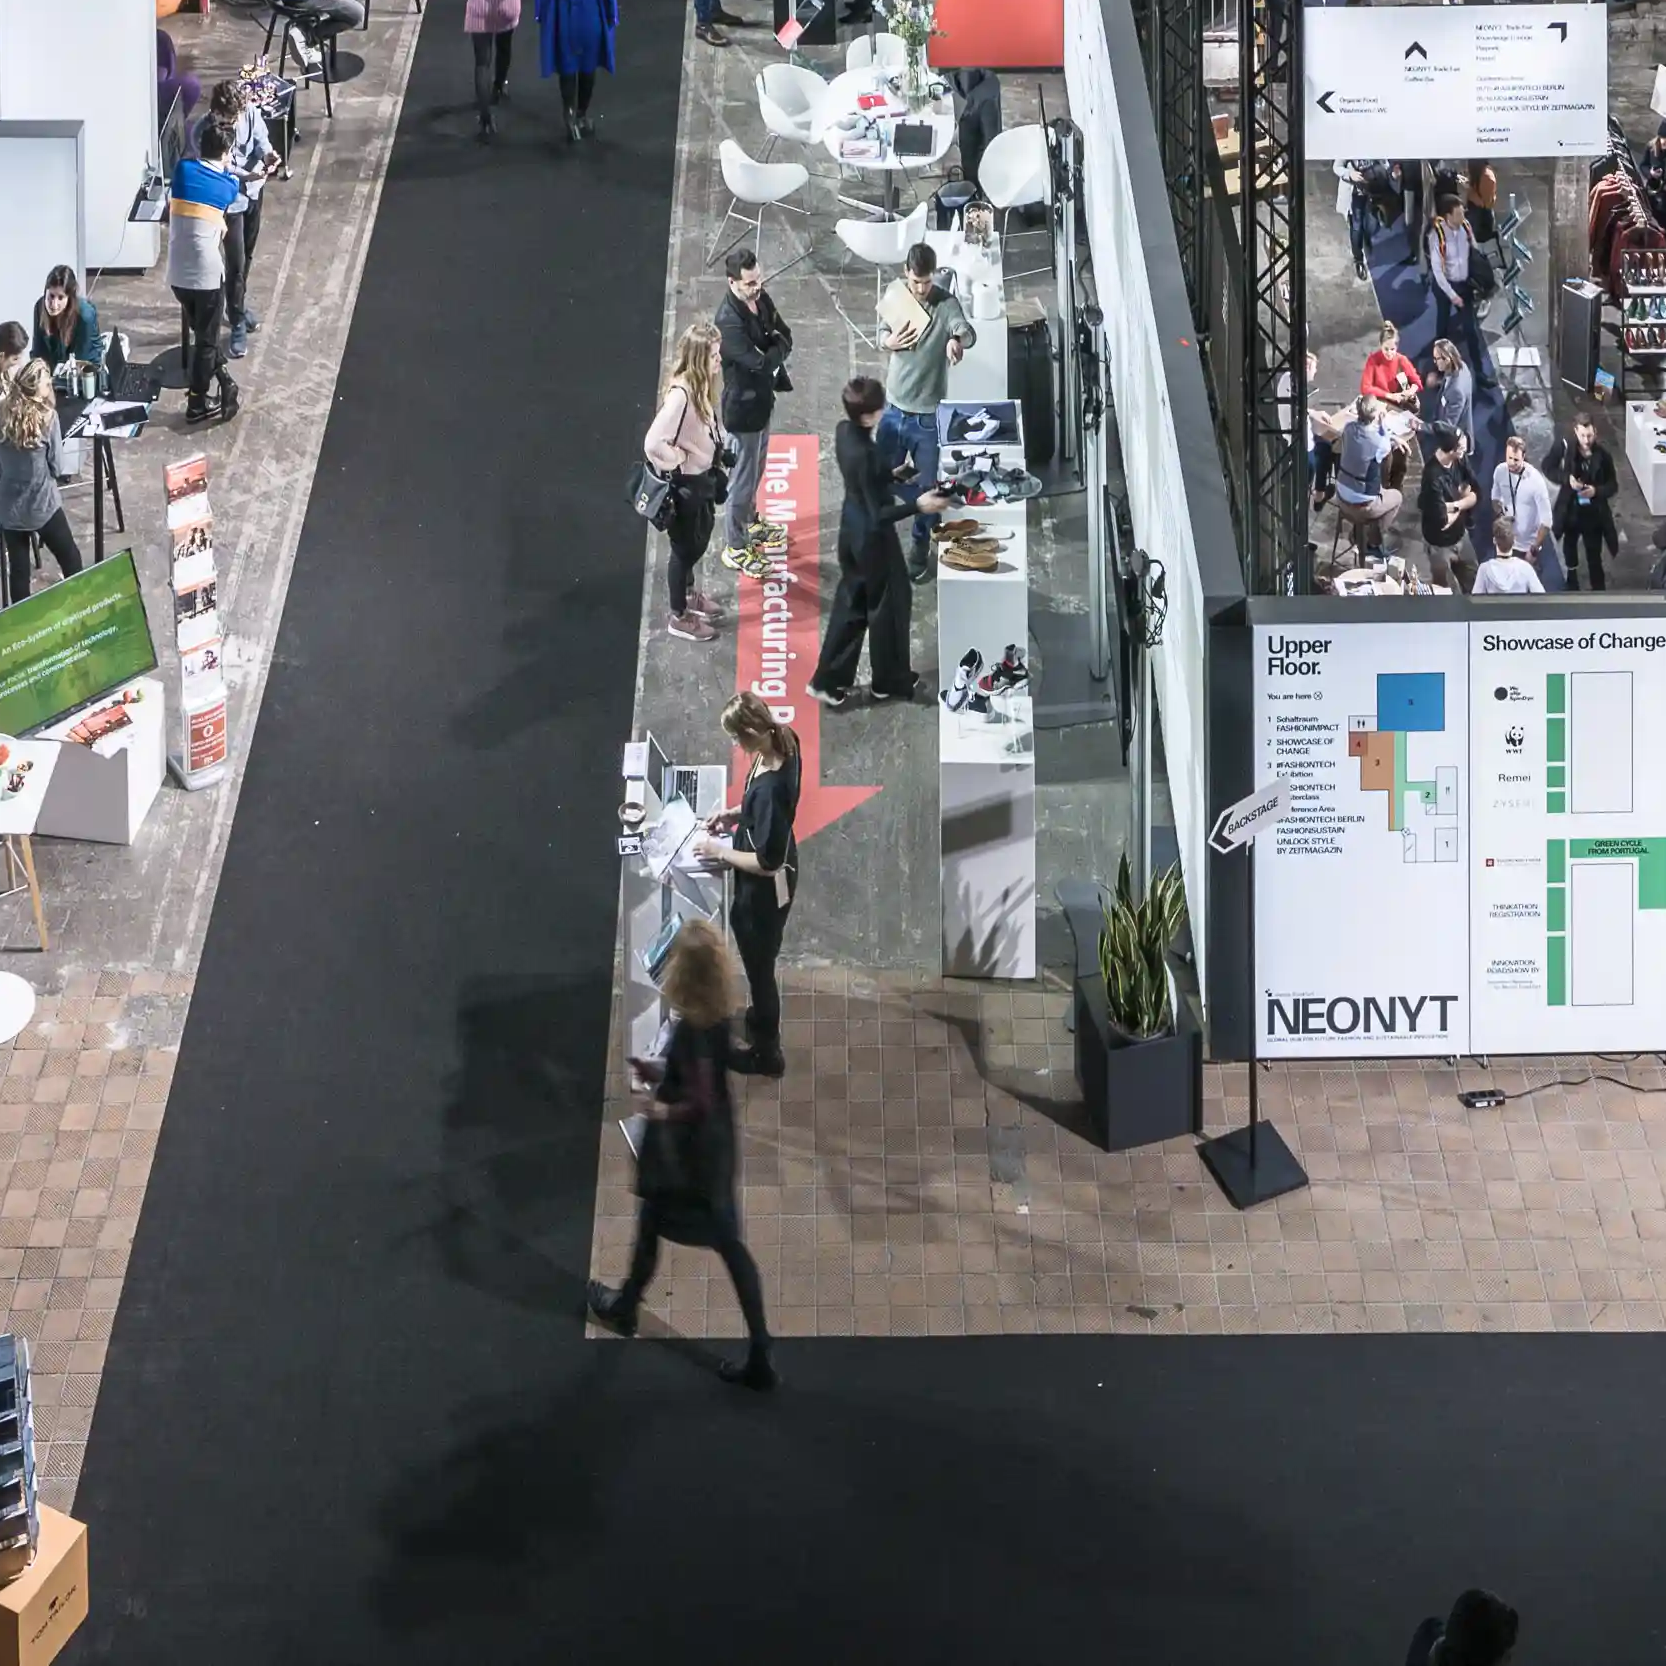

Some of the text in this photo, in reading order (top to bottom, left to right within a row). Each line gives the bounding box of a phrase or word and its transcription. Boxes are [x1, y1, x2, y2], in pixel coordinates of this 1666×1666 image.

[765, 448, 797, 494] The
[2, 646, 12, 656] An
[13, 627, 52, 651] Eco-System
[1268, 636, 1331, 658] Upper
[1483, 634, 1573, 651] Showcase
[1578, 633, 1596, 649] of
[27, 647, 73, 674] transformation
[1268, 658, 1321, 676] Floor.
[1277, 724, 1339, 732] FASHIONIMPACT
[1267, 738, 1334, 746] 2 SHOWCASE OF
[1498, 774, 1531, 782] Remei
[1228, 796, 1278, 835] BACKSTAGE
[1277, 837, 1335, 845] UNLOCK STYLE
[1267, 995, 1458, 1035] NEONYT
[48, 1584, 77, 1620] TAILOR
